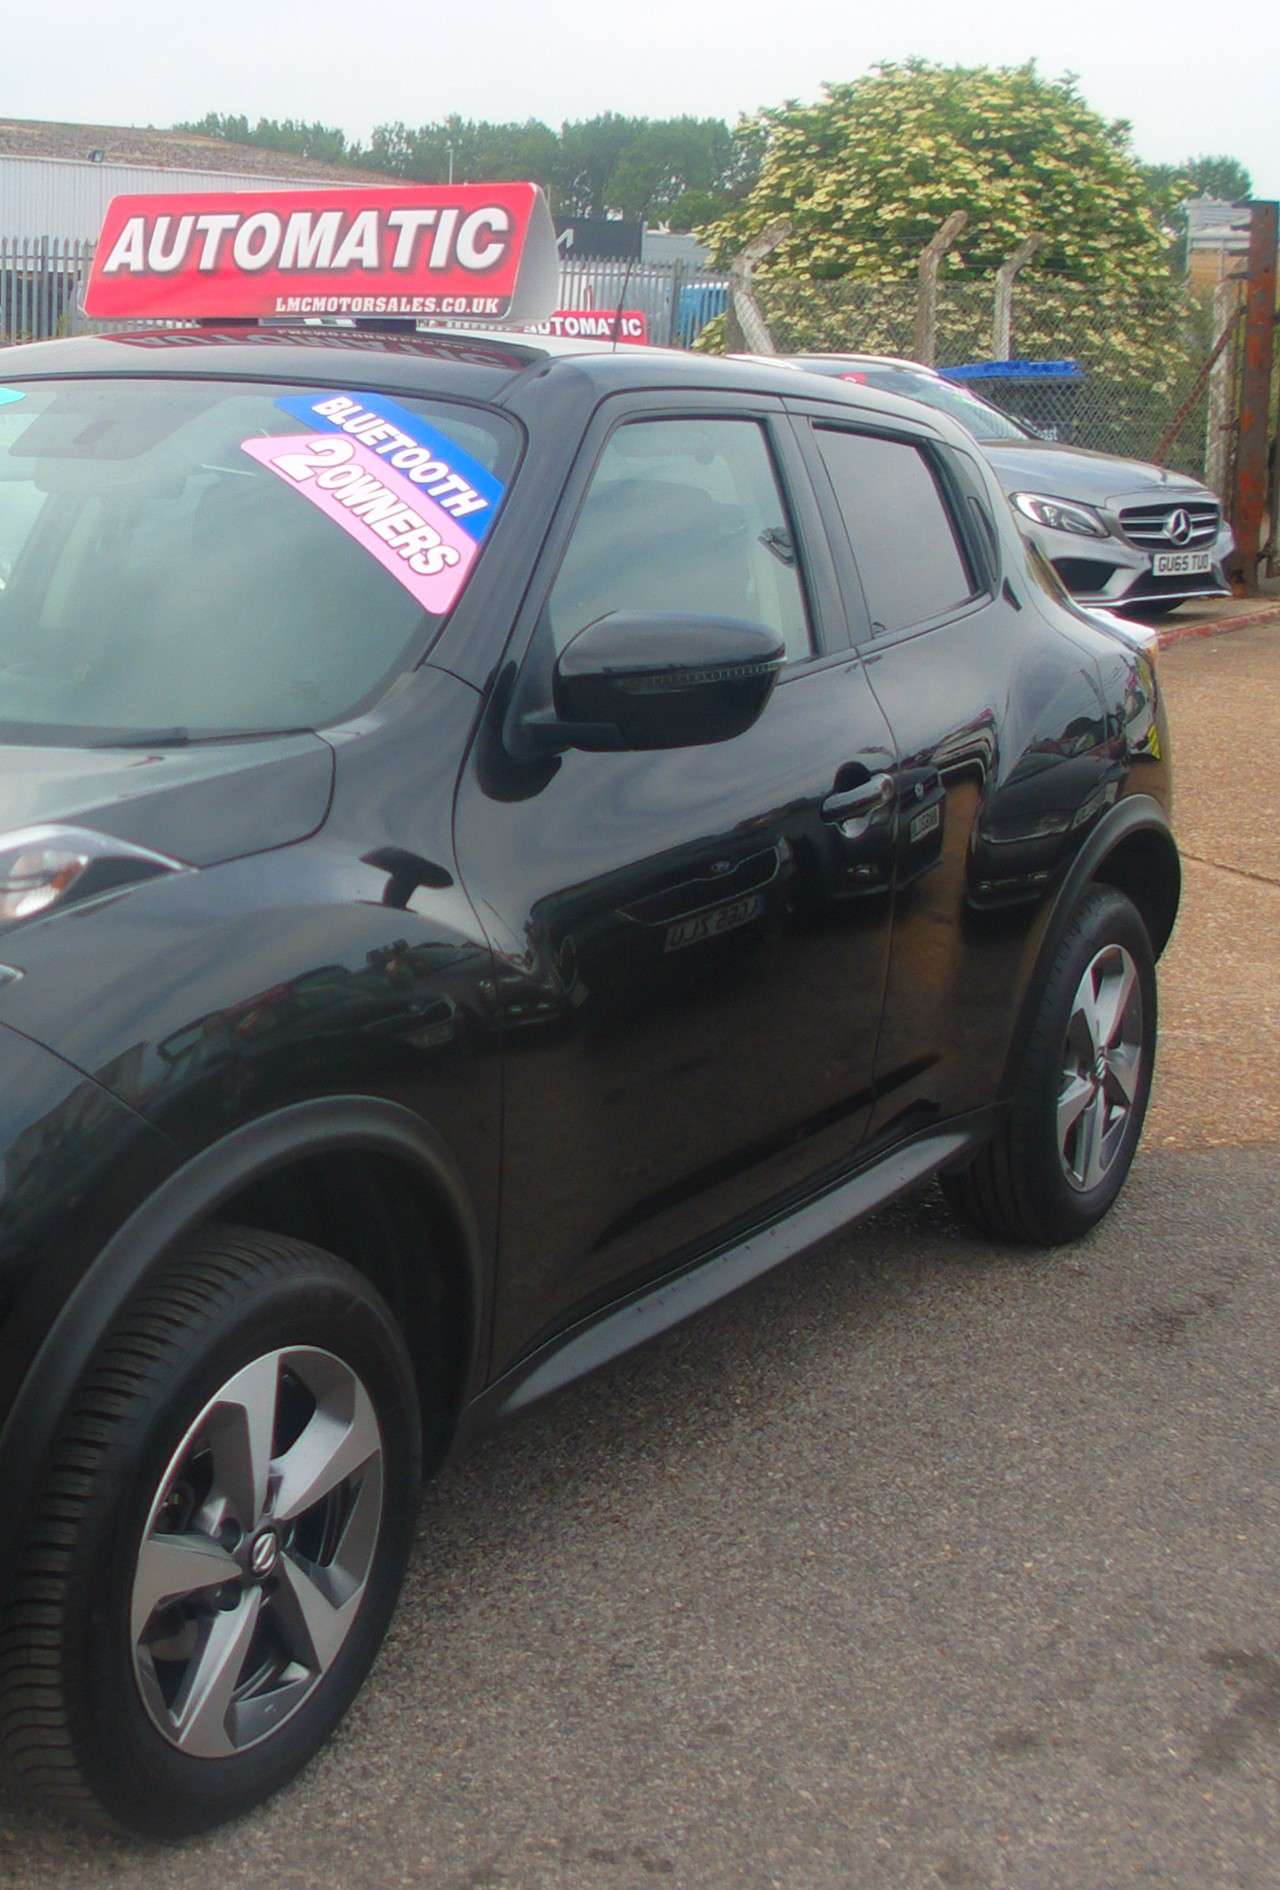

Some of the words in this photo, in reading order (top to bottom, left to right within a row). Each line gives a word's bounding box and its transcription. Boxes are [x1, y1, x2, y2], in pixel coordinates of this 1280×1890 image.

[103, 207, 508, 272] AUTOMATIC
[275, 297, 499, 313] LMCMOTORSALES.CO.UK
[311, 396, 488, 518] BLUETOOTH
[1159, 556, 1189, 571] GU65
